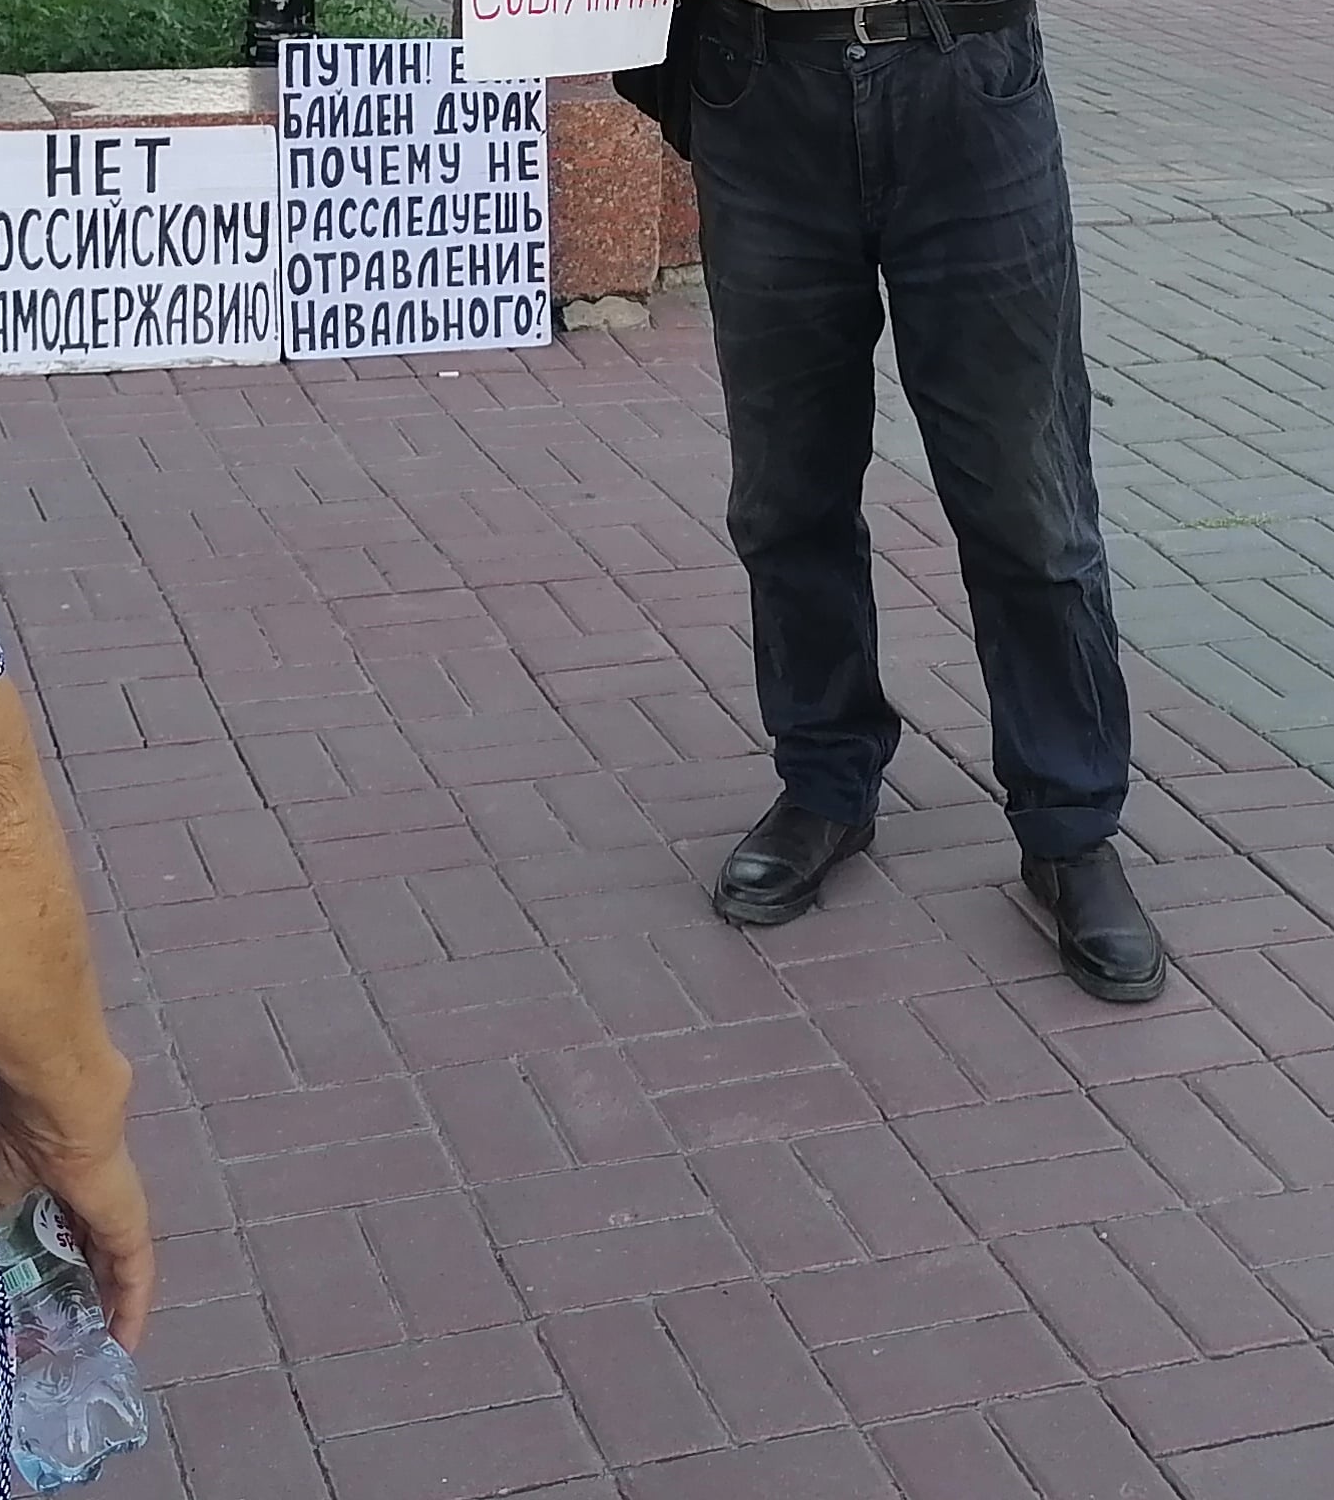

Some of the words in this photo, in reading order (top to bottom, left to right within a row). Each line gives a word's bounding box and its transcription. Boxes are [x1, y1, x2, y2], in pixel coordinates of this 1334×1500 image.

[284, 41, 432, 87] ПУТИН!
[284, 87, 414, 139] БАЙДЕН
[45, 134, 170, 198] НЕТ
[290, 143, 461, 190] ПОЧЕМУ
[488, 139, 540, 183] НЕ
[287, 192, 544, 243] РАССЛЕДУЕШЬ
[287, 241, 547, 297] ОТРАВЛЕНИЕ
[291, 289, 548, 354] НАВАЛЬНОГО?
